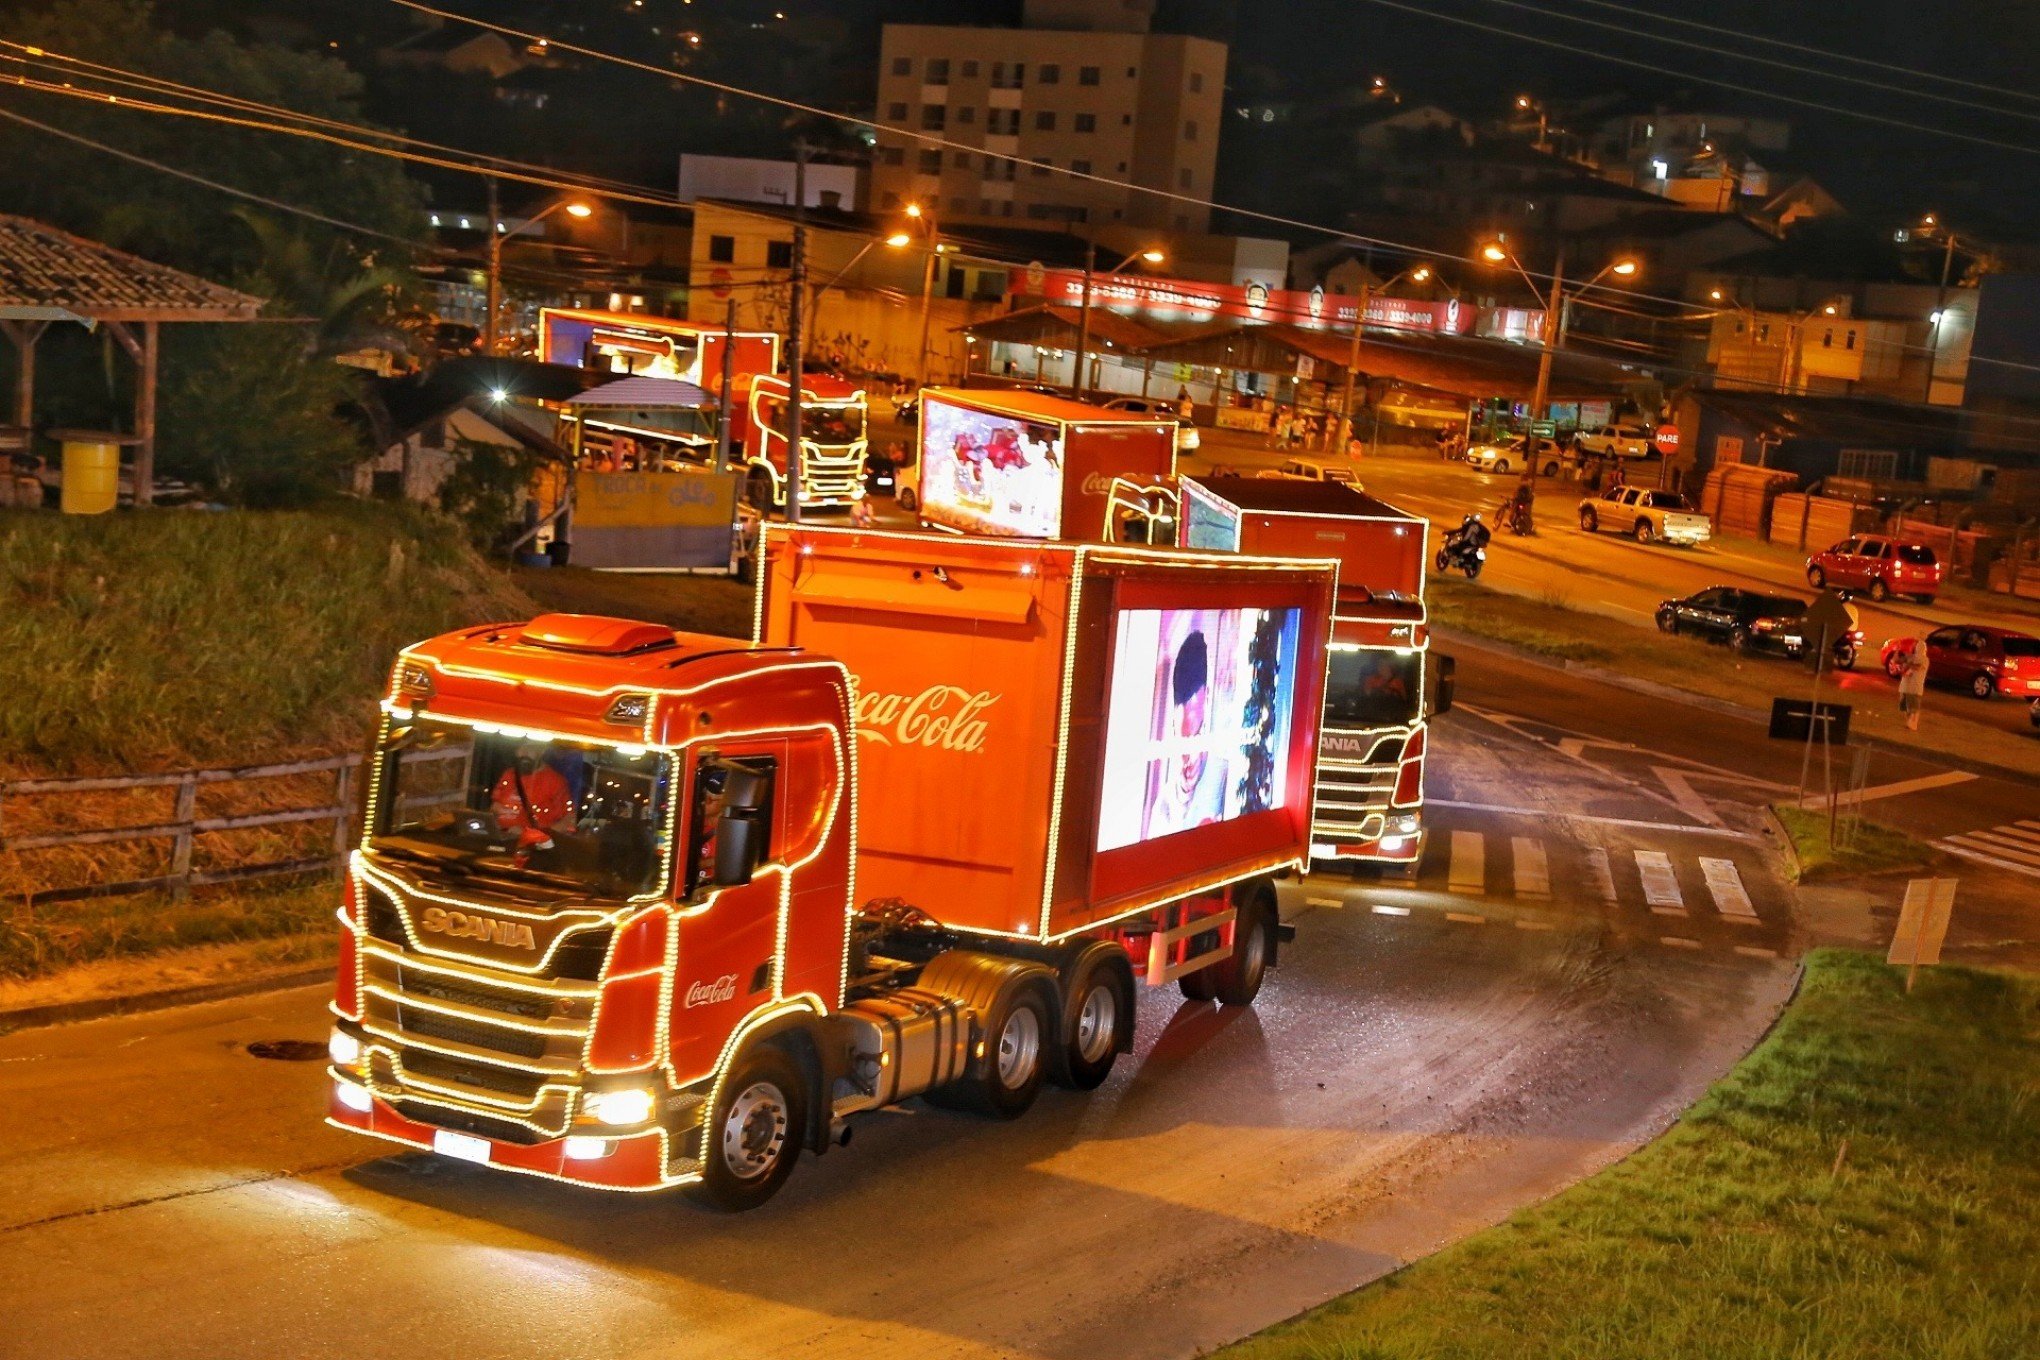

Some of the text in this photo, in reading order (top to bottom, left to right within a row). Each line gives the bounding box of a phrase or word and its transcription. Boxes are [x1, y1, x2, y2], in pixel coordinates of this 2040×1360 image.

[1656, 434, 1678, 444] PARE
[851, 674, 1002, 753] oca-Cola
[1321, 737, 1361, 752] ANIA
[422, 907, 536, 951] SCANIA
[684, 973, 739, 1009] Coca-Cola
